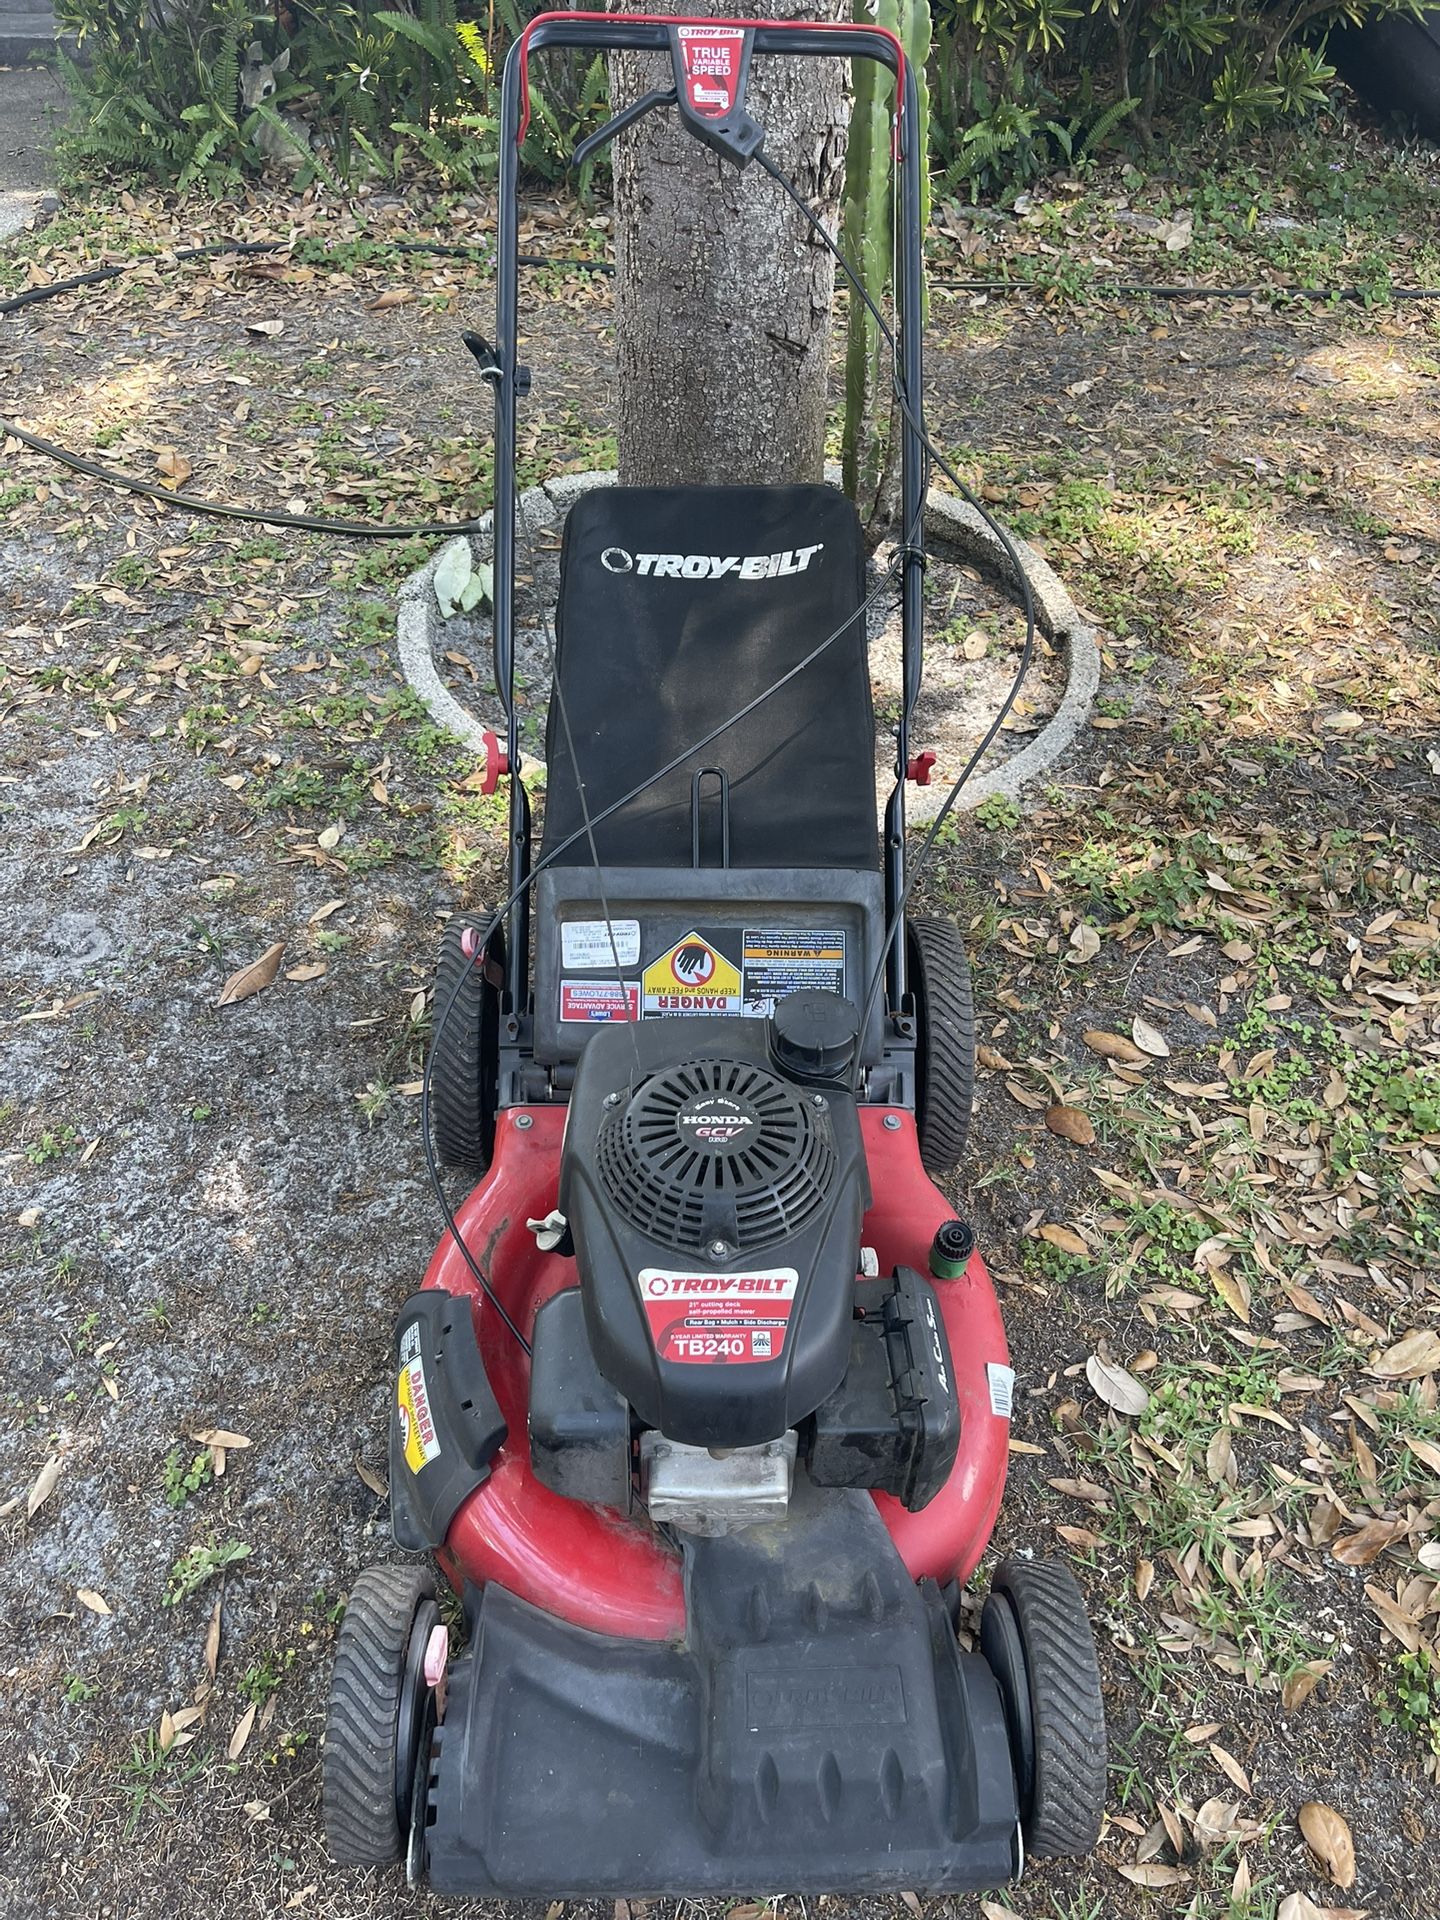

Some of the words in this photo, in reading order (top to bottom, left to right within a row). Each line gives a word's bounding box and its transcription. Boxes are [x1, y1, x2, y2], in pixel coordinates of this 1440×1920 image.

[692, 47, 731, 59] TRUE
[692, 65, 732, 76] SPEED
[635, 545, 819, 579] TROY-BILT
[647, 987, 667, 995] AWAY
[668, 987, 684, 995] FEET
[685, 987, 696, 995] and
[697, 987, 719, 995] HANDS
[568, 1002, 605, 1010] ADVANTAGE
[606, 1002, 633, 1010] SRVICE
[658, 996, 727, 1009] DANGER
[683, 1116, 753, 1124] HONDA
[695, 1127, 745, 1137] GCV
[671, 1278, 788, 1294] TROY-BILT
[689, 1308, 733, 1316] self-propelled
[674, 1339, 744, 1356] TB240
[410, 1369, 435, 1446] DANGER
[416, 1438, 427, 1462] AWAY
